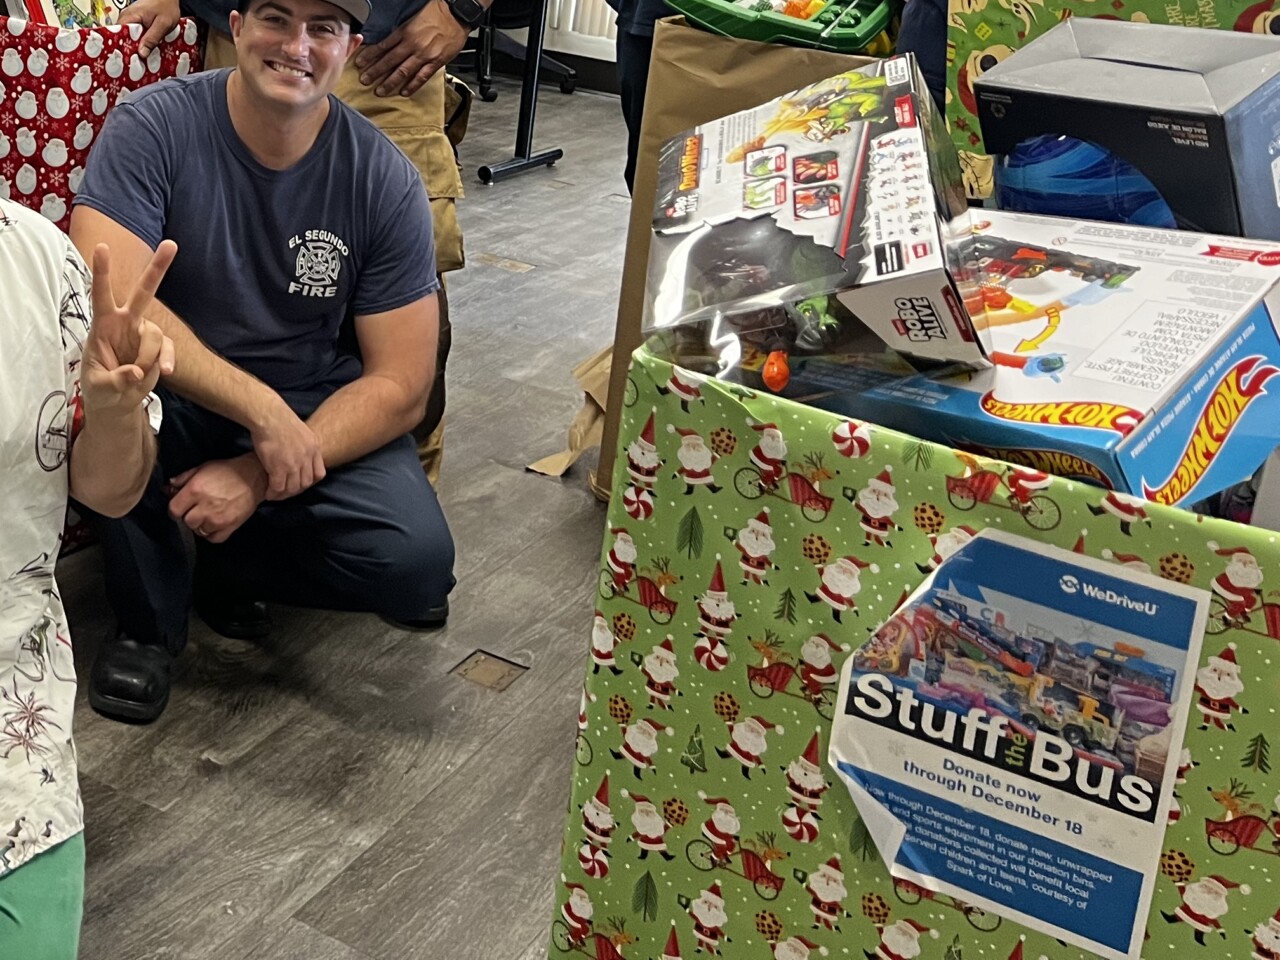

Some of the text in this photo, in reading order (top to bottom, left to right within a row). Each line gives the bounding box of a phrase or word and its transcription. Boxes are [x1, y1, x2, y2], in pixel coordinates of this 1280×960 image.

[1172, 137, 1194, 145] LEVEL
[288, 229, 349, 256] EL SEGUNDO
[288, 281, 338, 297] FIRE
[895, 297, 931, 342] ROBO
[910, 297, 947, 340] ALIVE
[1082, 582, 1158, 616] WeDriveU
[853, 674, 1155, 813] Stuff the Bus
[903, 761, 1083, 835] through December 18
[943, 758, 1042, 802] Donate now
[888, 791, 924, 813] through
[926, 805, 976, 833] December
[995, 830, 1029, 852] donate
[1057, 856, 1113, 883] unwrapped
[912, 812, 942, 831] sports
[944, 821, 995, 852] equipment
[996, 845, 1006, 856] in
[1008, 850, 1025, 862] our
[1027, 854, 1070, 879] donation
[914, 823, 962, 850] donations
[963, 839, 1008, 866] collected
[1010, 857, 1026, 874] will
[1028, 864, 1063, 888] benefit
[1065, 881, 1089, 899] local
[939, 843, 976, 867] children
[978, 860, 997, 875] and
[1032, 881, 1074, 906] courtesy
[1076, 899, 1088, 910] of
[946, 860, 974, 879] Spark
[976, 873, 988, 884] of
